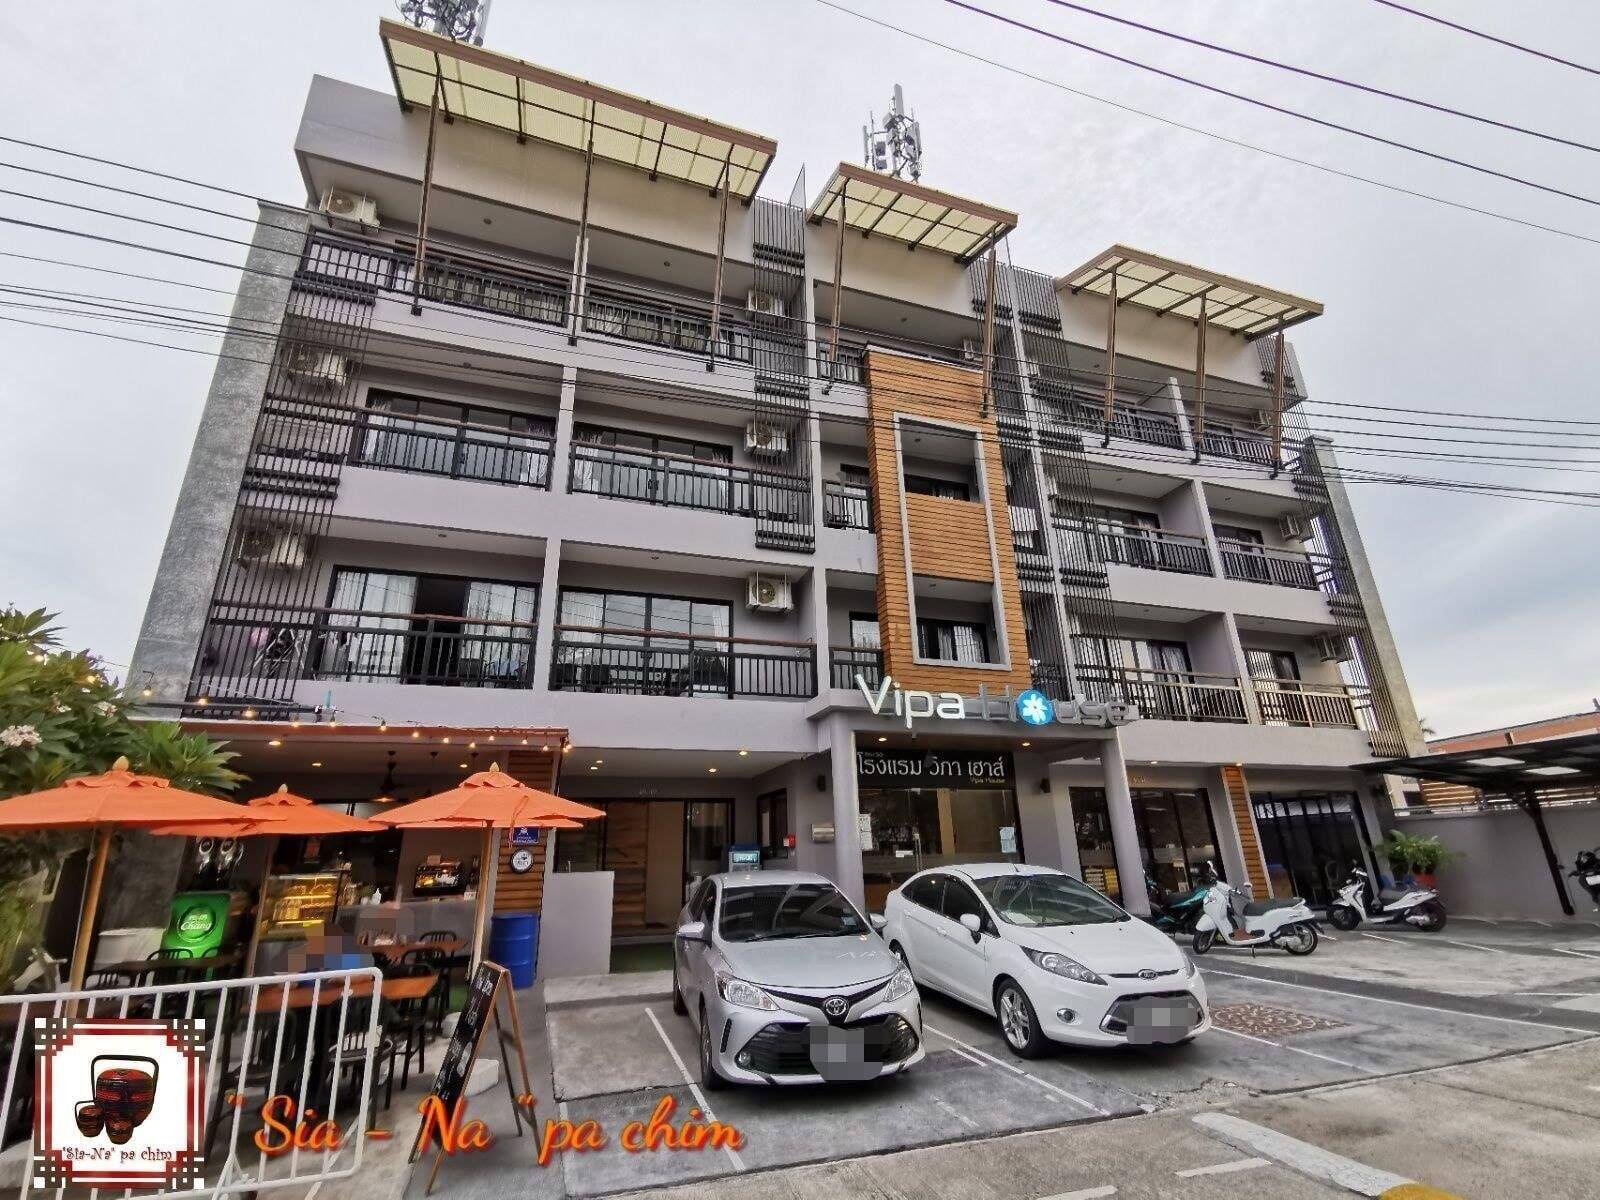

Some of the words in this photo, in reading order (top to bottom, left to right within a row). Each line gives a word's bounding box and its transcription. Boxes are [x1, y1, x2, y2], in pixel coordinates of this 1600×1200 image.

[854, 673, 966, 729] Vipa
[857, 751, 922, 776] โรงแรม
